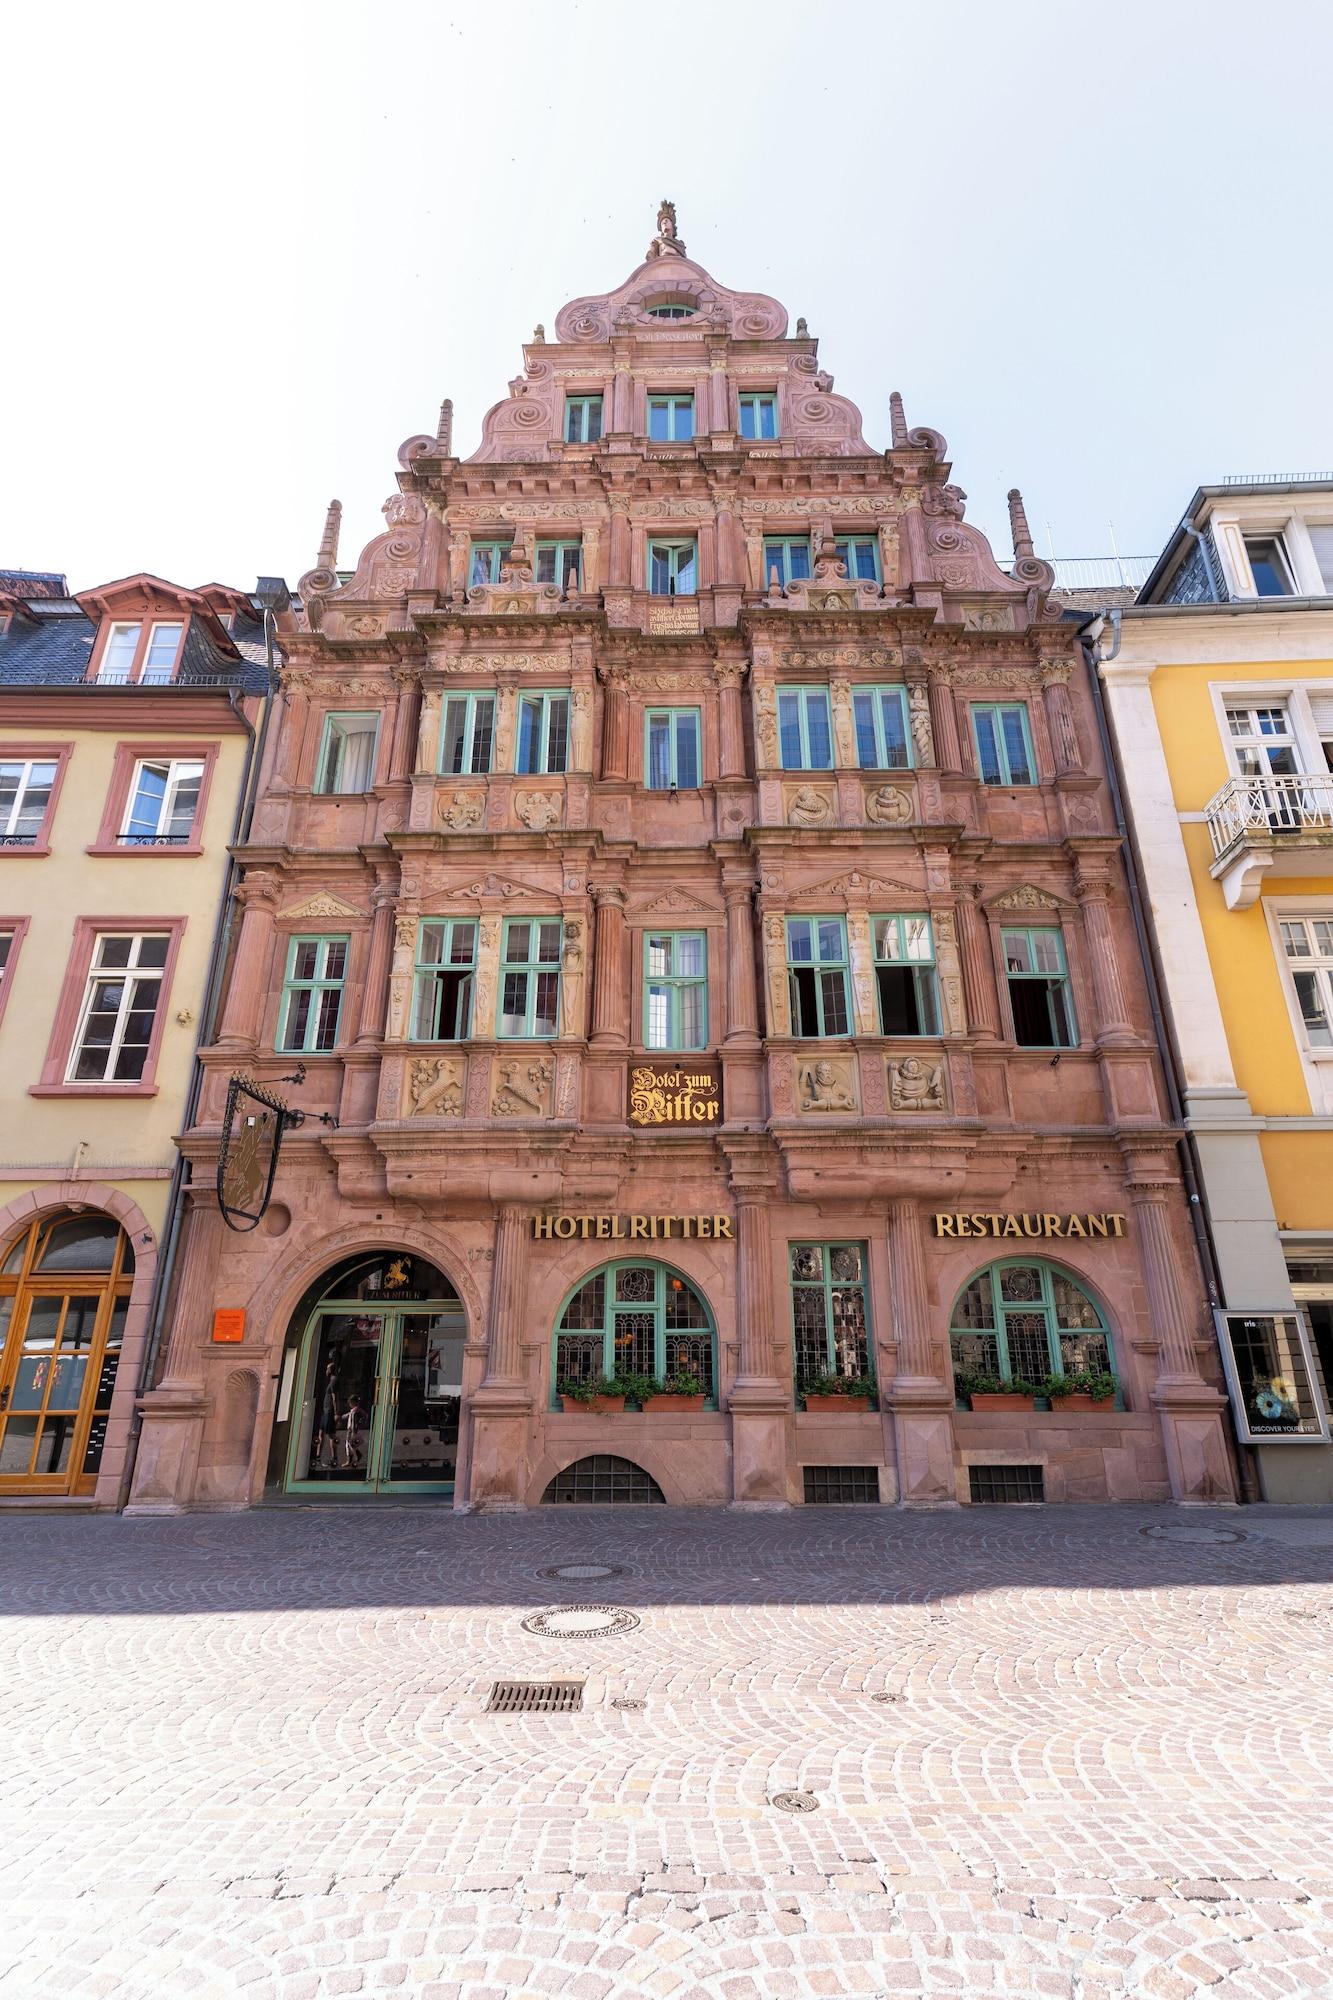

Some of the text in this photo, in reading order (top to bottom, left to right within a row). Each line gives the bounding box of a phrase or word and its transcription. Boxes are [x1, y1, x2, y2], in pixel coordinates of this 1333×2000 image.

[632, 1066, 717, 1095] Hotel zum
[630, 1088, 719, 1125] Ritter
[534, 1214, 734, 1239] HOTEL RITTER
[935, 1213, 1126, 1238] RESTAURANT
[467, 1248, 494, 1261] 178
[1282, 1425, 1300, 1433] YOUR
